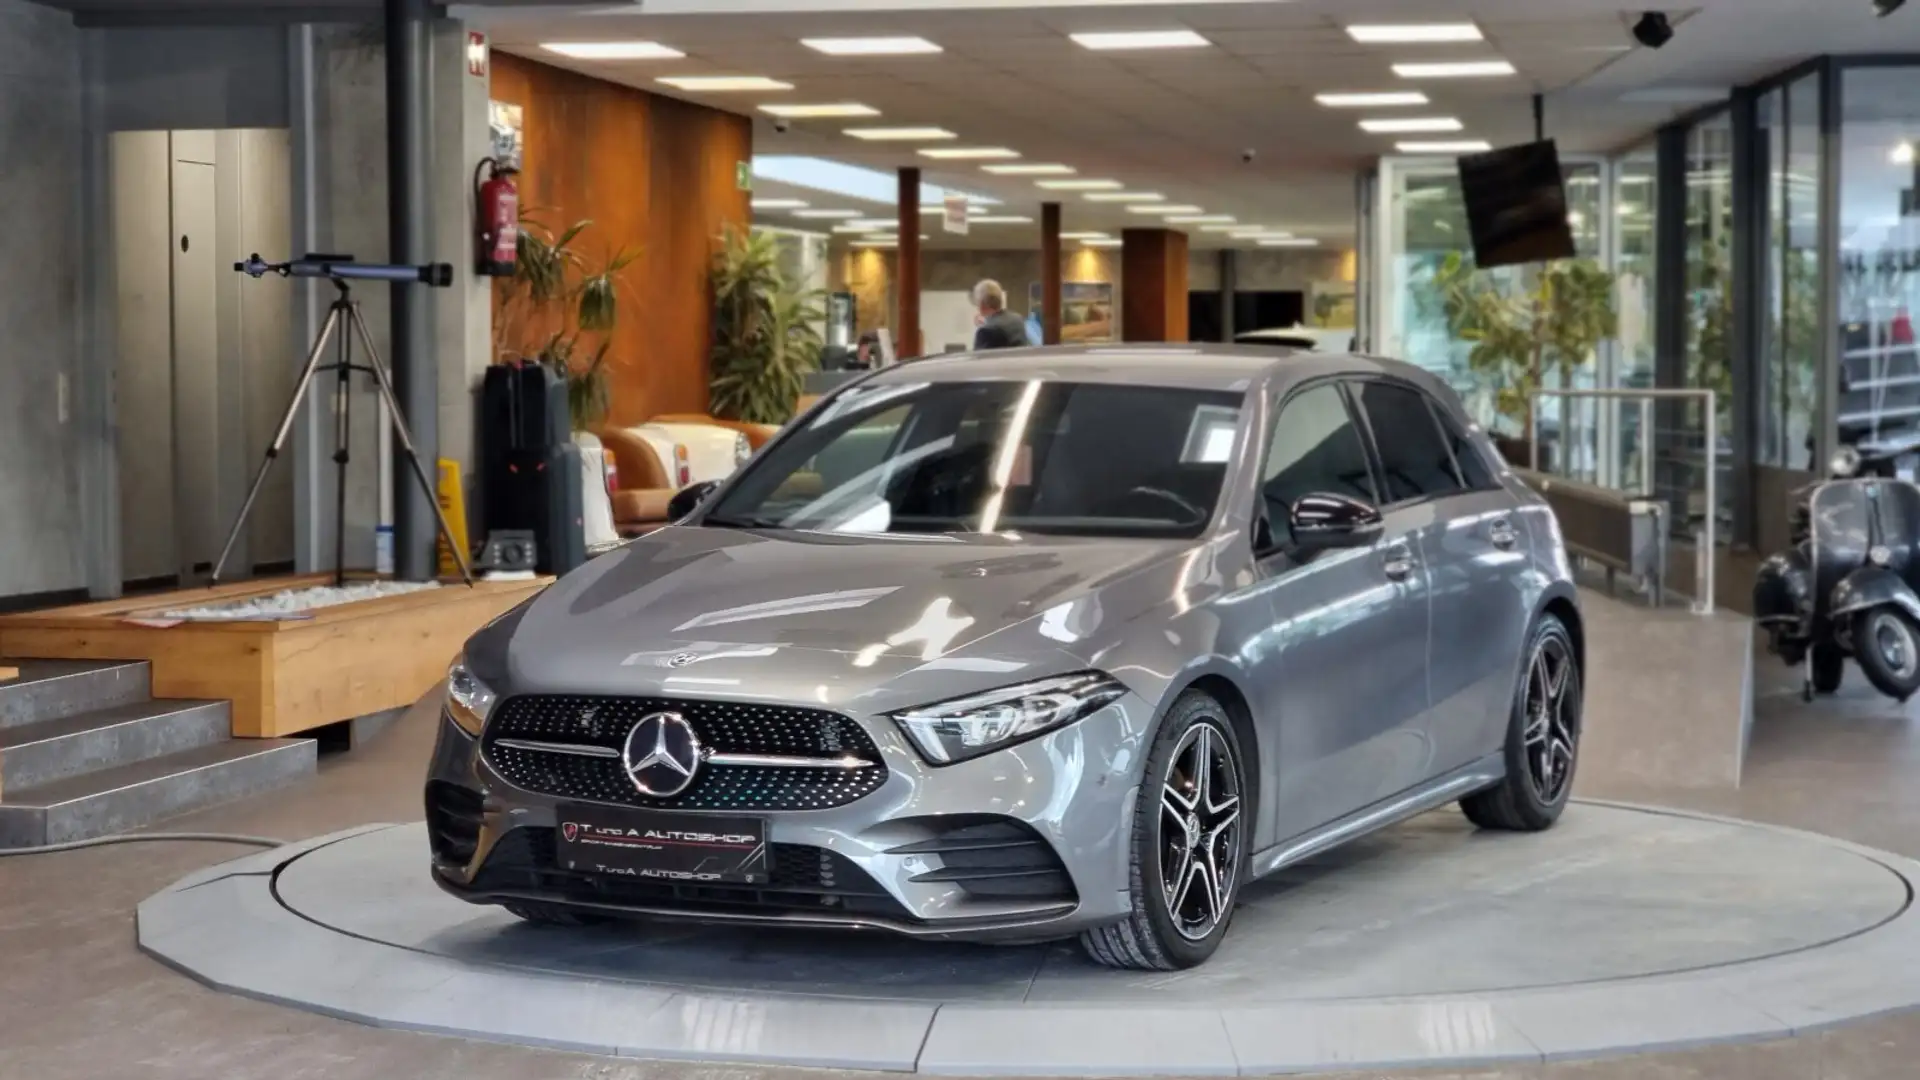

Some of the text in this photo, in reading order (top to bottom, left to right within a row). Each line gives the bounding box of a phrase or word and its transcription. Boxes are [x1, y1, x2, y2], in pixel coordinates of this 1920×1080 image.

[580, 823, 592, 832] T
[627, 828, 639, 837] A
[644, 829, 756, 843] AUTOSHOP
[596, 864, 606, 872] T
[626, 867, 636, 876] A
[641, 869, 721, 880] AUTOSHOP
